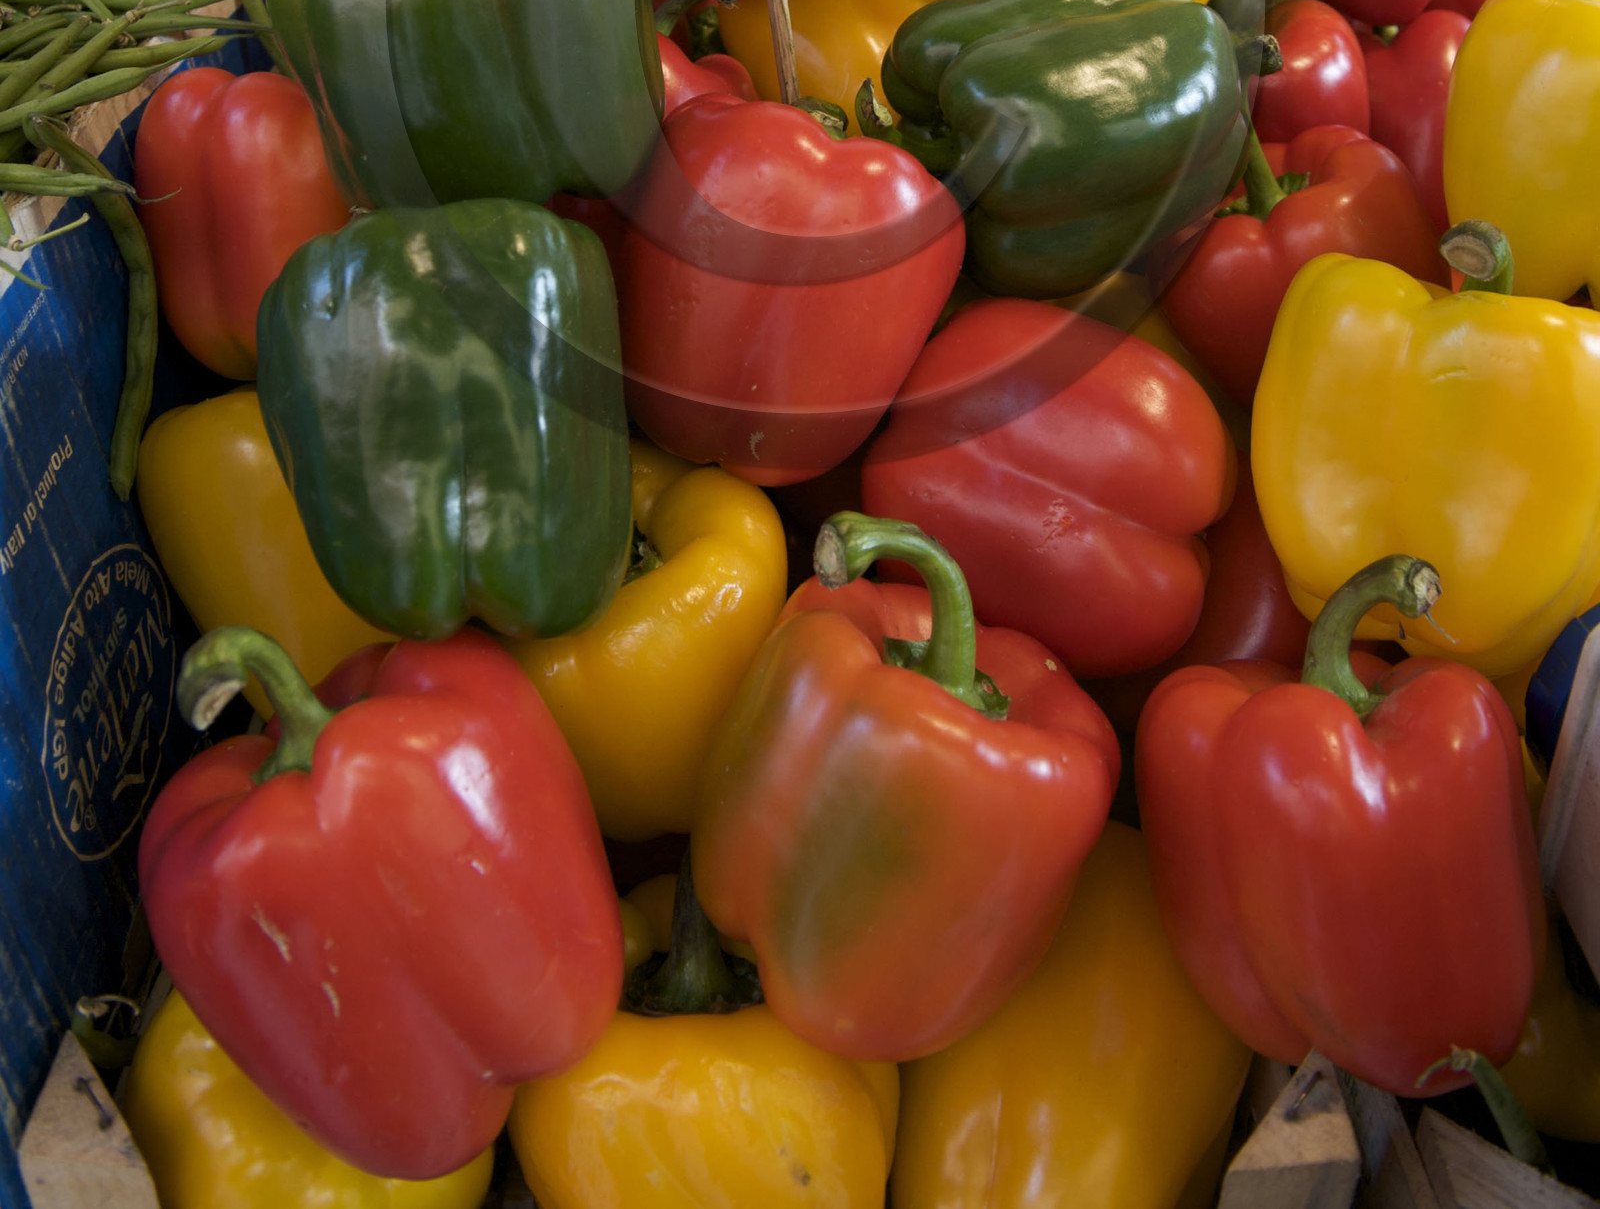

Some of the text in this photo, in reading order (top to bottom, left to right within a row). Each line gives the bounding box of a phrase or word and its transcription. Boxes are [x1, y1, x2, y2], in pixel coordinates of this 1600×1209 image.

[0, 434, 73, 576] Product of Italy
[53, 560, 150, 780] Mela Alto Adige IGP
